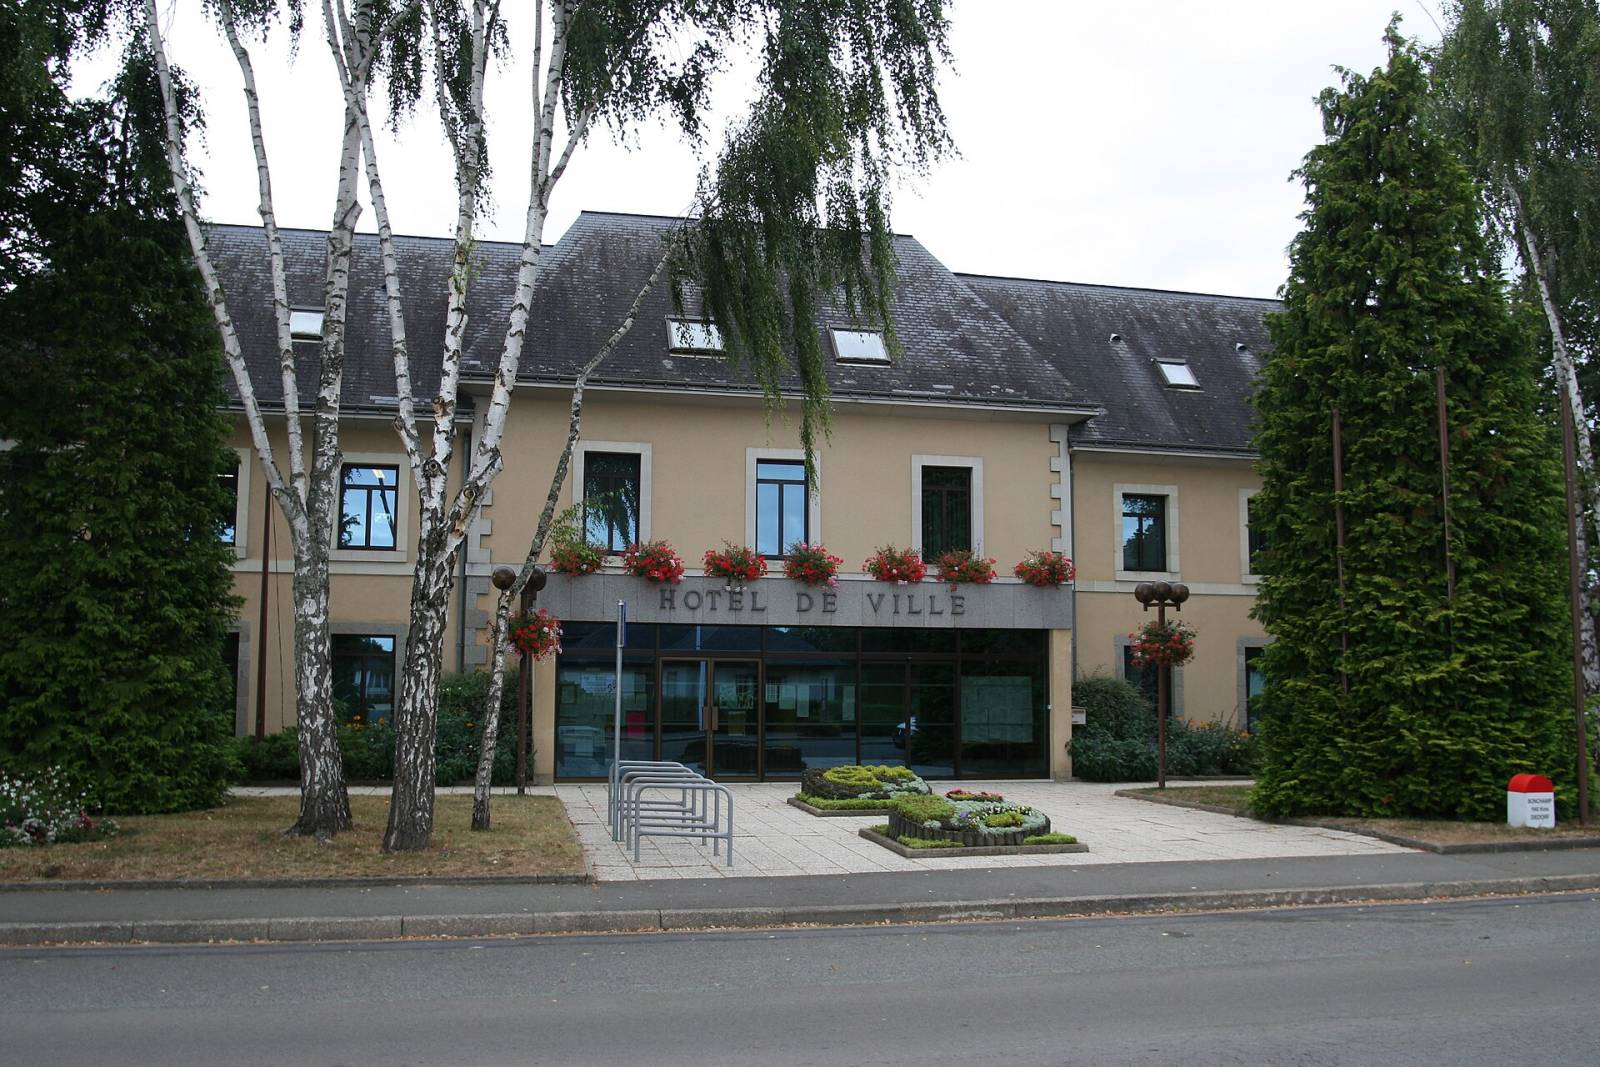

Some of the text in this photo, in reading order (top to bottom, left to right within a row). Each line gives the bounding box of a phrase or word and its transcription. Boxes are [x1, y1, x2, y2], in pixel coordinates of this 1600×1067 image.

[659, 588, 967, 616] HOTEL DE VILLE
